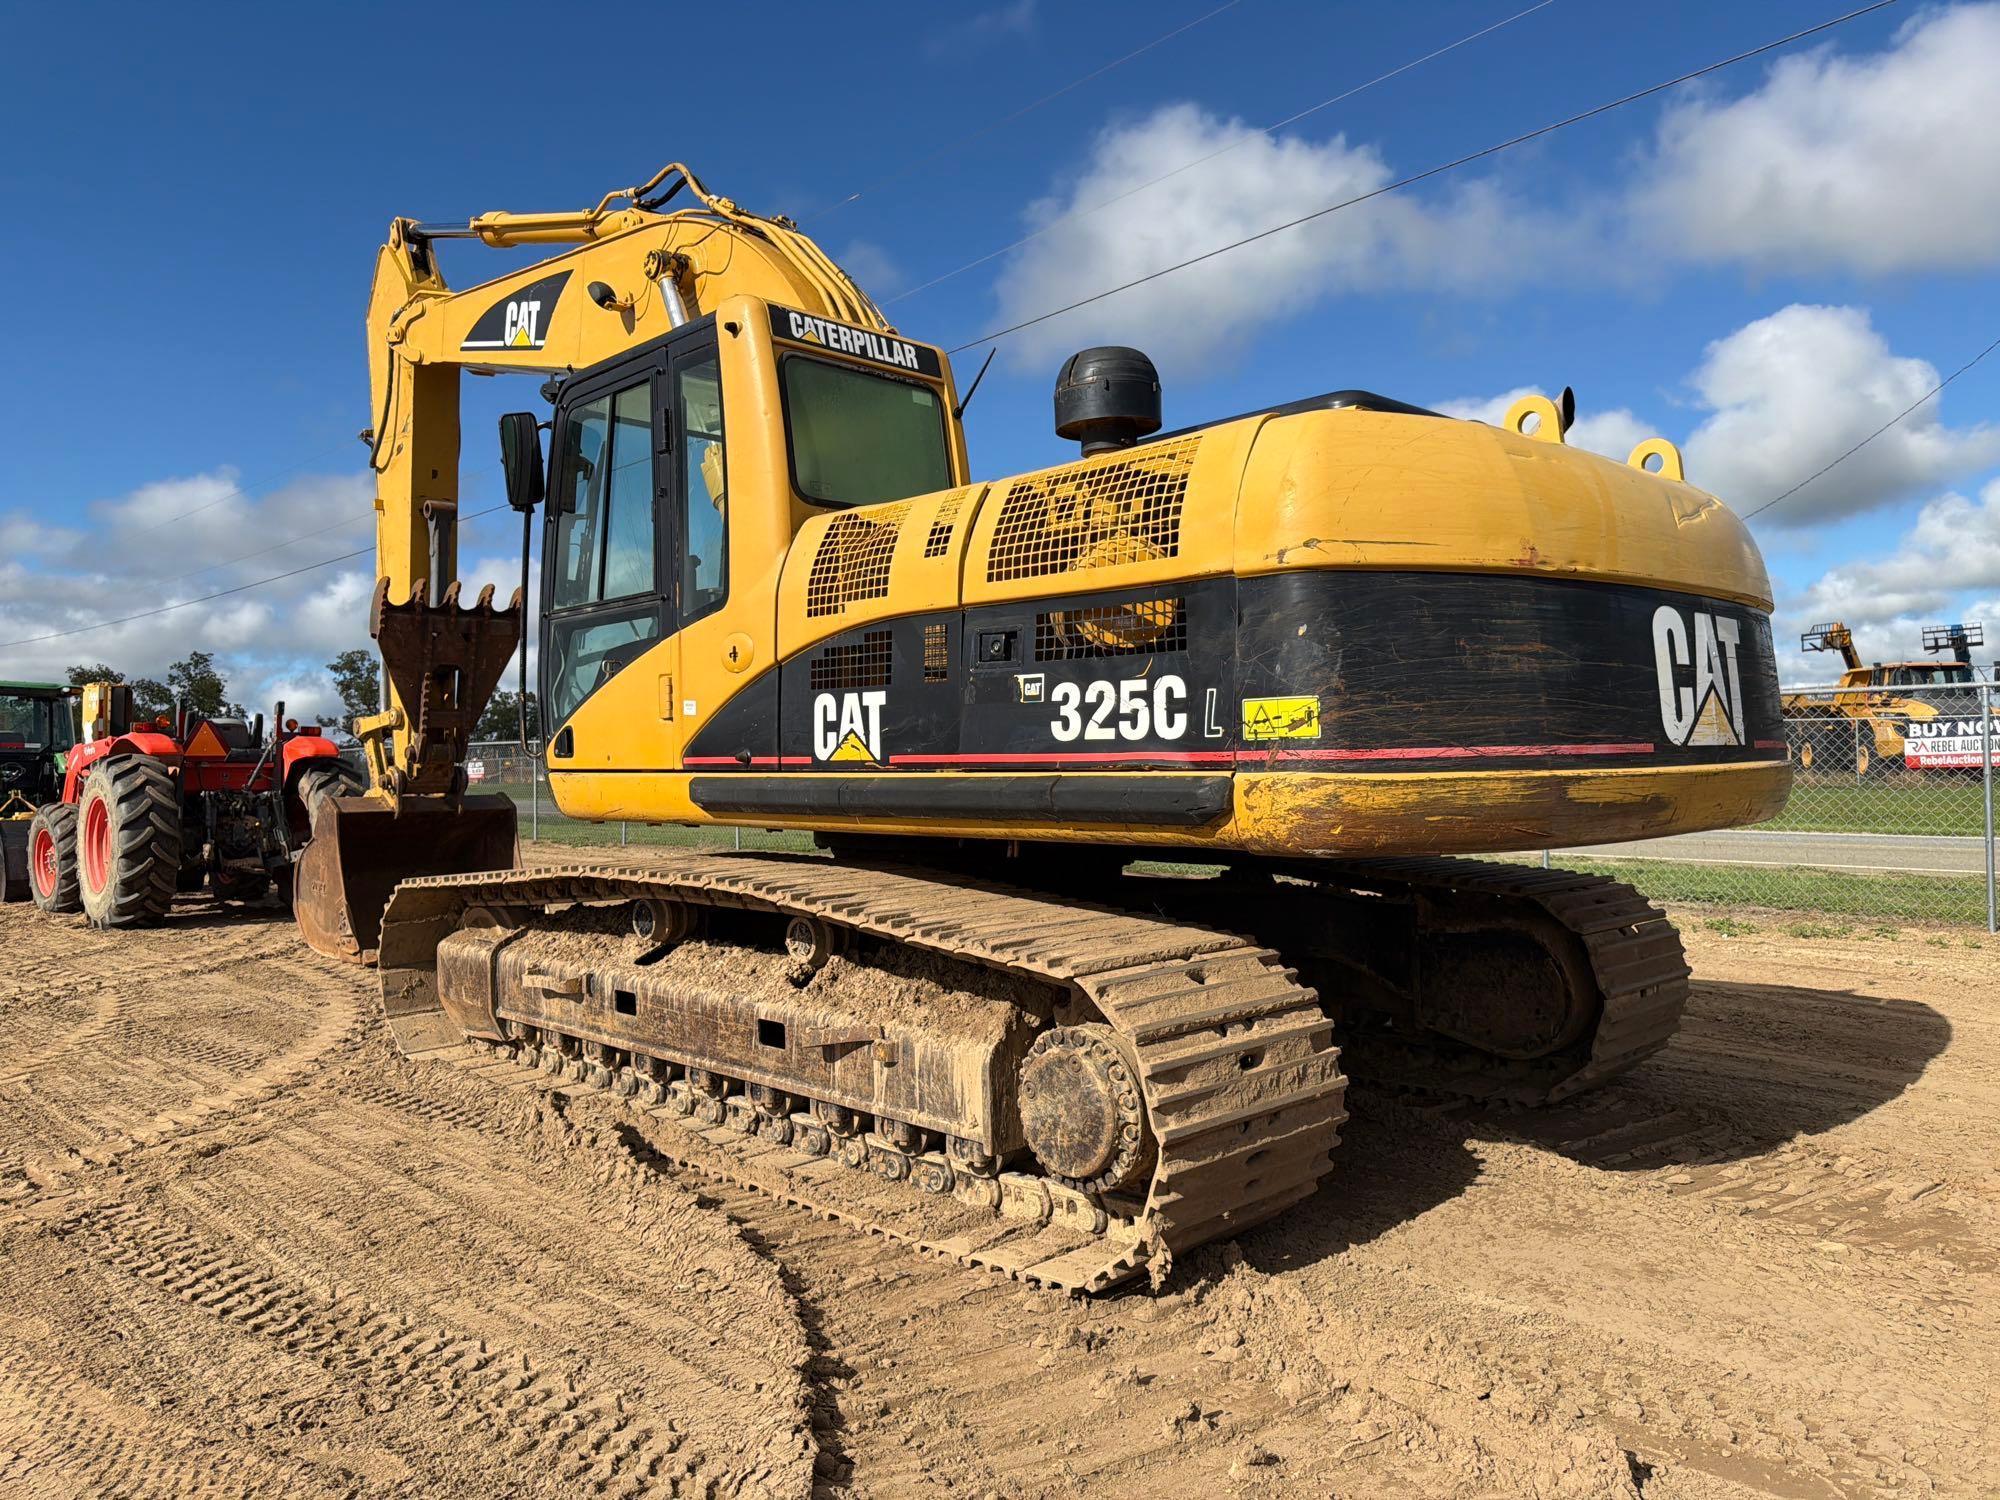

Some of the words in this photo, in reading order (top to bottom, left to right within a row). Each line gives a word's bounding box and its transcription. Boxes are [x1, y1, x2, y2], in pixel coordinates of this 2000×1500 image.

[504, 301, 541, 347] CAT
[788, 312, 919, 370] CATERPILLAR
[1024, 682, 1042, 696] CAT
[1652, 605, 1746, 747] CAT
[813, 690, 887, 761] CAT
[1050, 675, 1188, 742] 325C
[1204, 688, 1223, 738] L
[1908, 722, 1952, 738] BUY
[1930, 740, 1958, 753] REBEL
